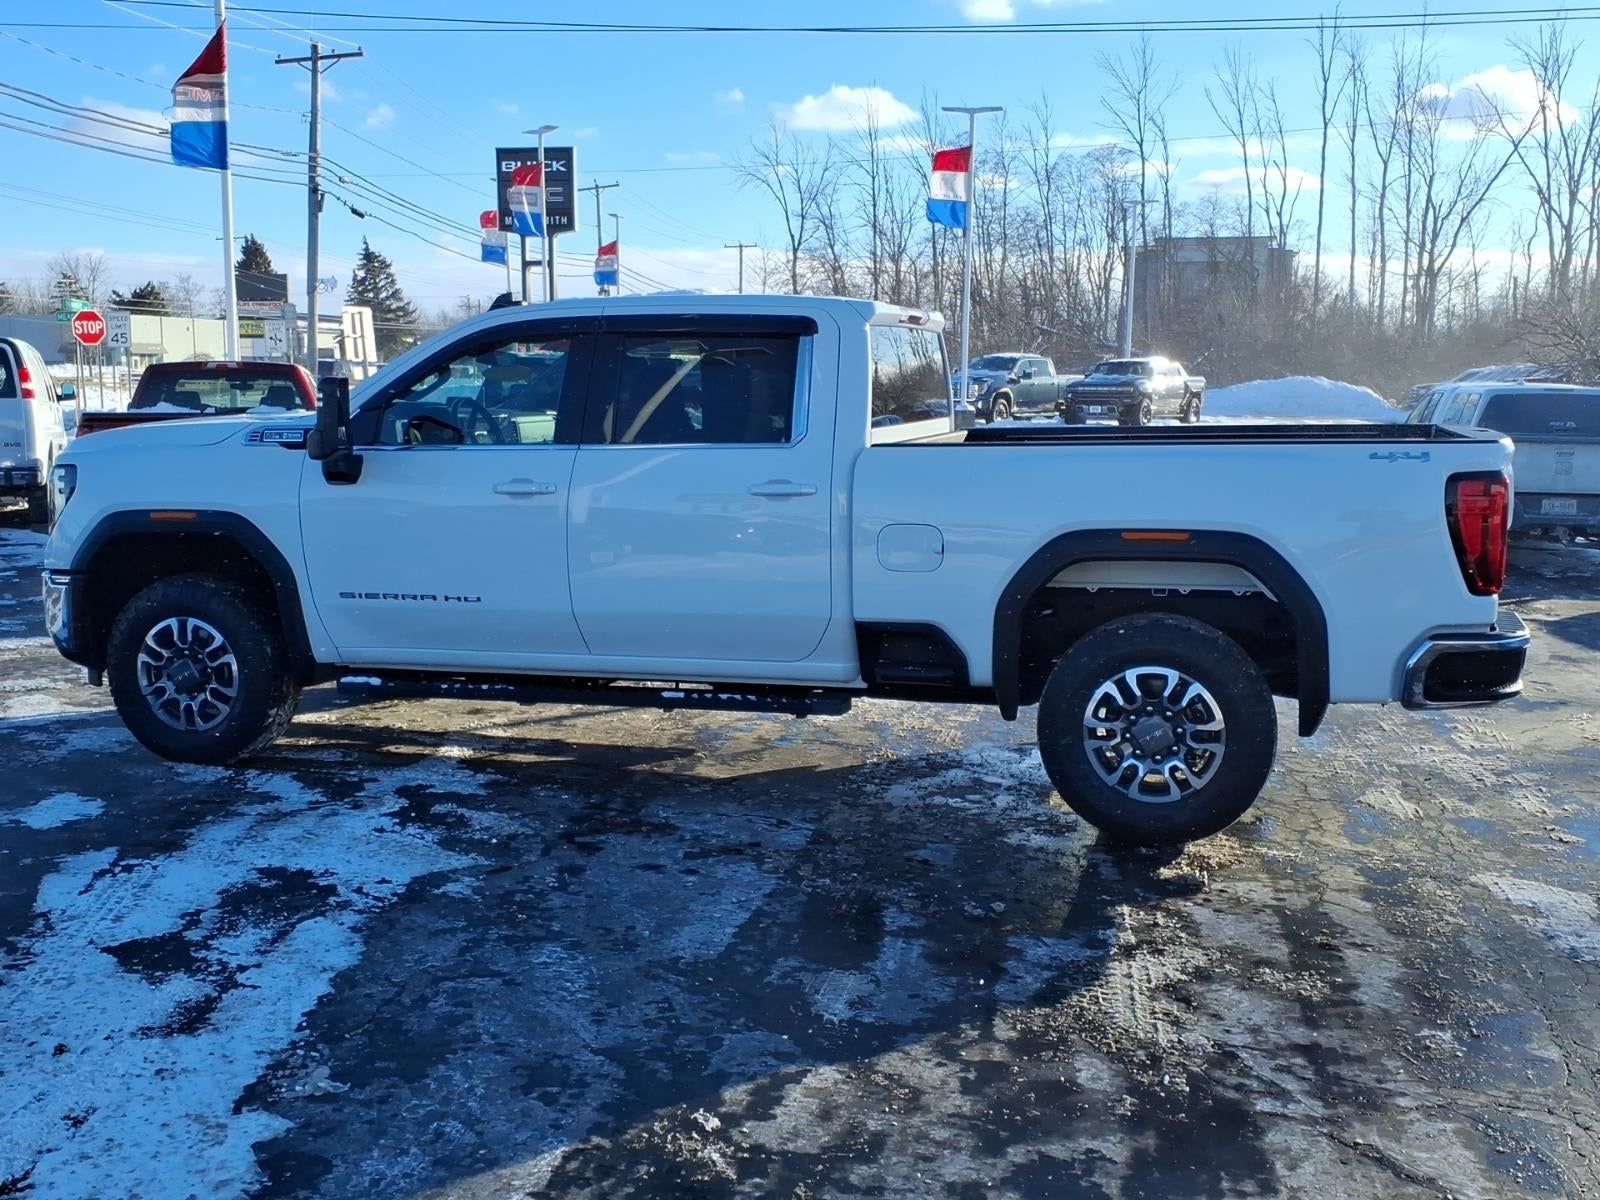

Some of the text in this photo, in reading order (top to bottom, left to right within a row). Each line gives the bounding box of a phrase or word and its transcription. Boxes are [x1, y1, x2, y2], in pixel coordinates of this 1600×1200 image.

[501, 161, 567, 172] BCK
[74, 320, 103, 335] STOP
[111, 332, 128, 344] 45
[338, 591, 482, 603] SIERRA HD
